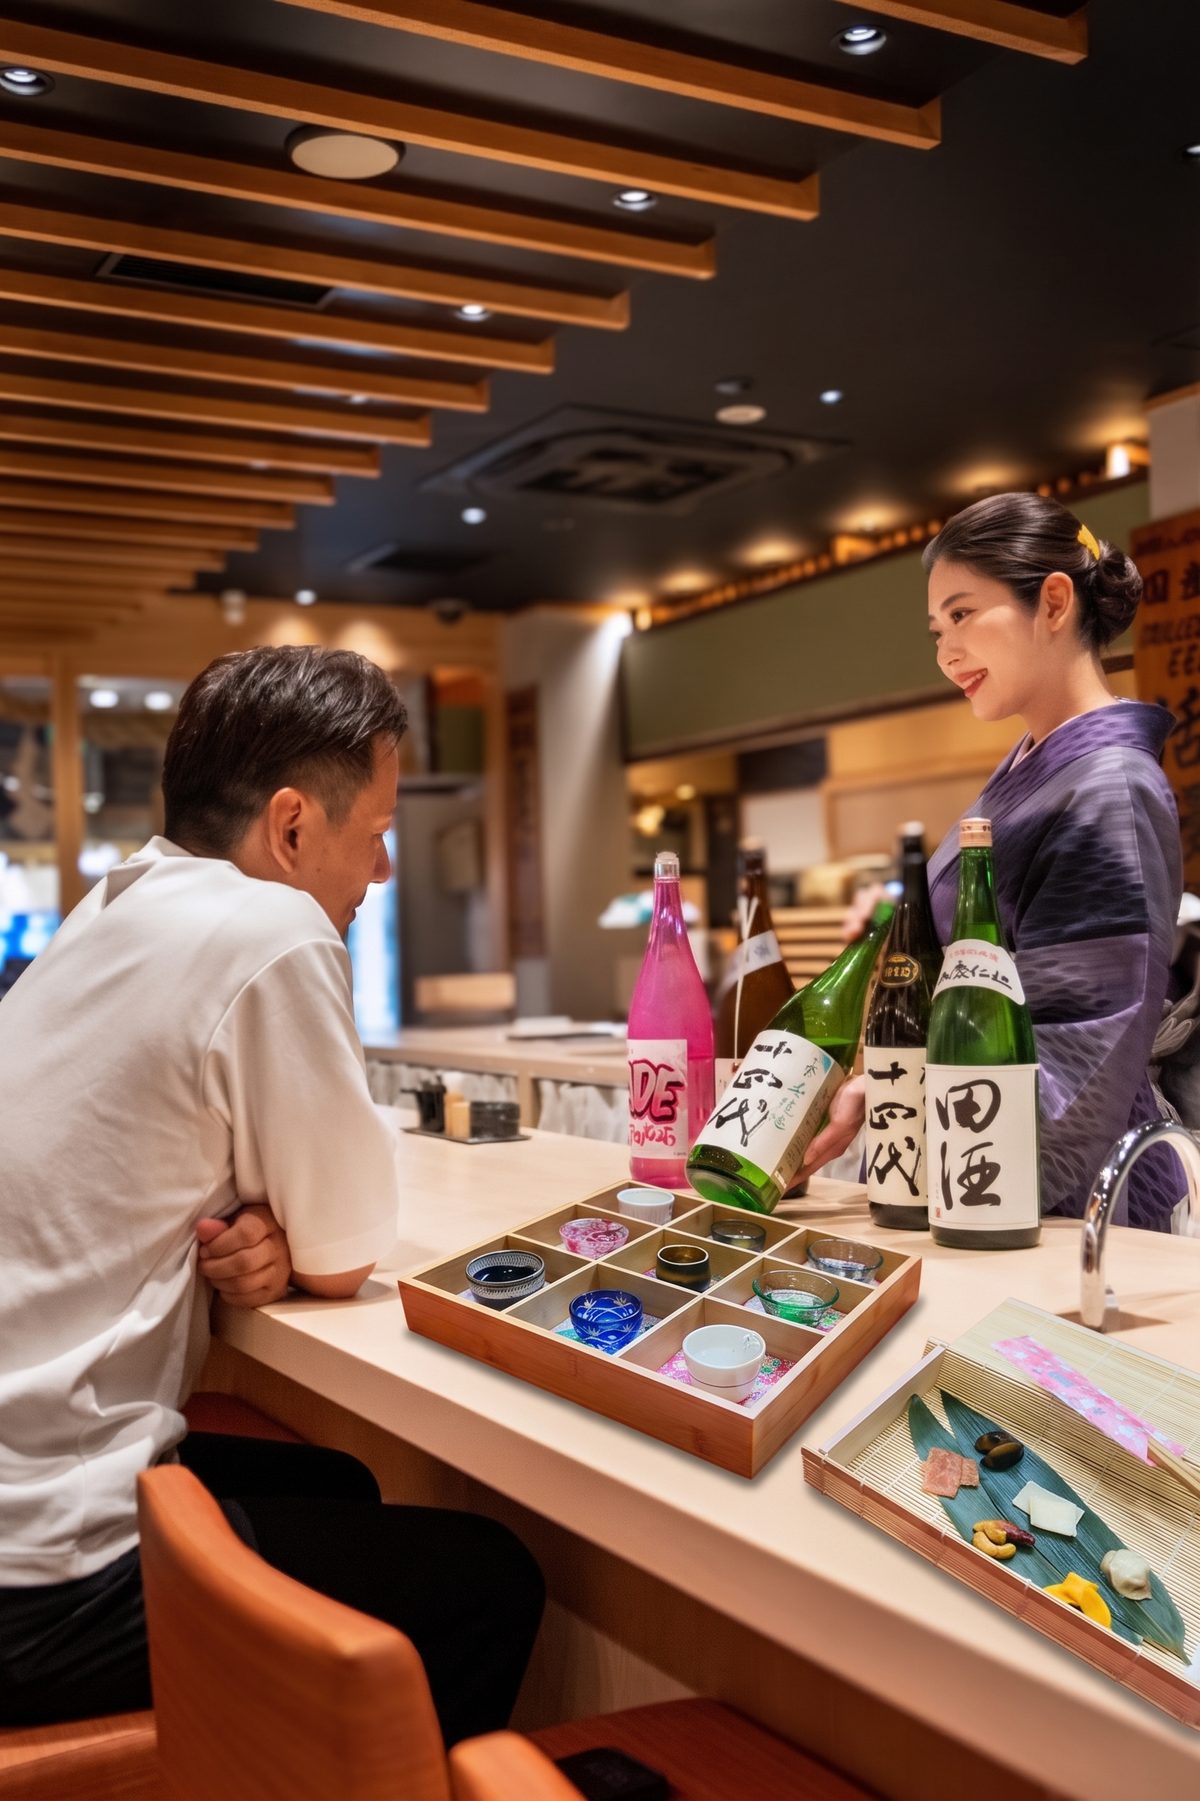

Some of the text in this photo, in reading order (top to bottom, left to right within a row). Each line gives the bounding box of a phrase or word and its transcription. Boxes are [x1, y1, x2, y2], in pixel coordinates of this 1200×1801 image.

[628, 1058, 685, 1125] DE
[707, 1041, 793, 1147] 十四代
[867, 1061, 922, 1197] 十四代
[935, 1079, 1002, 1211] 田酒
